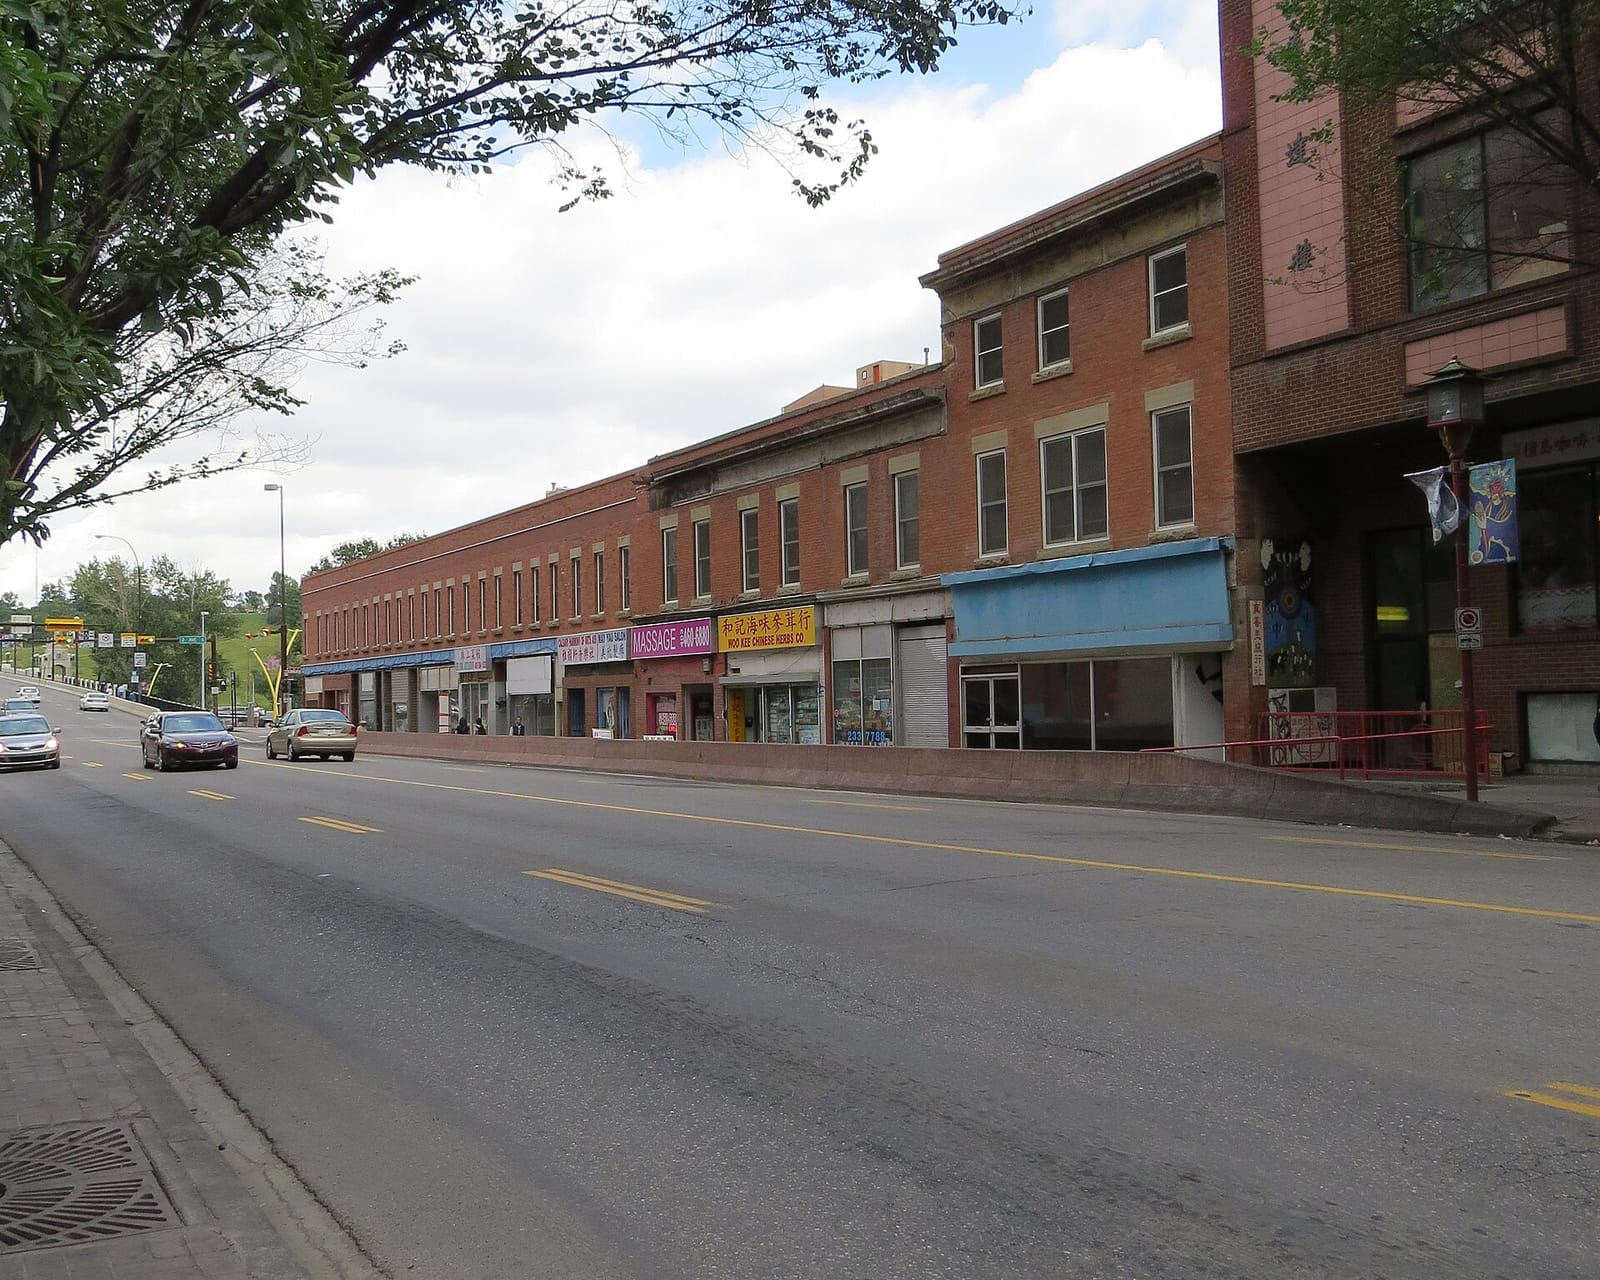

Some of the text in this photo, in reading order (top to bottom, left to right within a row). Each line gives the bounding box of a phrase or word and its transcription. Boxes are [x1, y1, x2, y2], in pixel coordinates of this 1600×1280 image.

[722, 609, 811, 637] 和記海味參茸行
[633, 628, 677, 653] MASSAGE
[728, 638, 739, 649] WOO
[741, 637, 750, 648] KEE
[752, 634, 774, 646] CHINESE
[775, 633, 794, 645] HERBS
[847, 731, 886, 742] 233 7788
